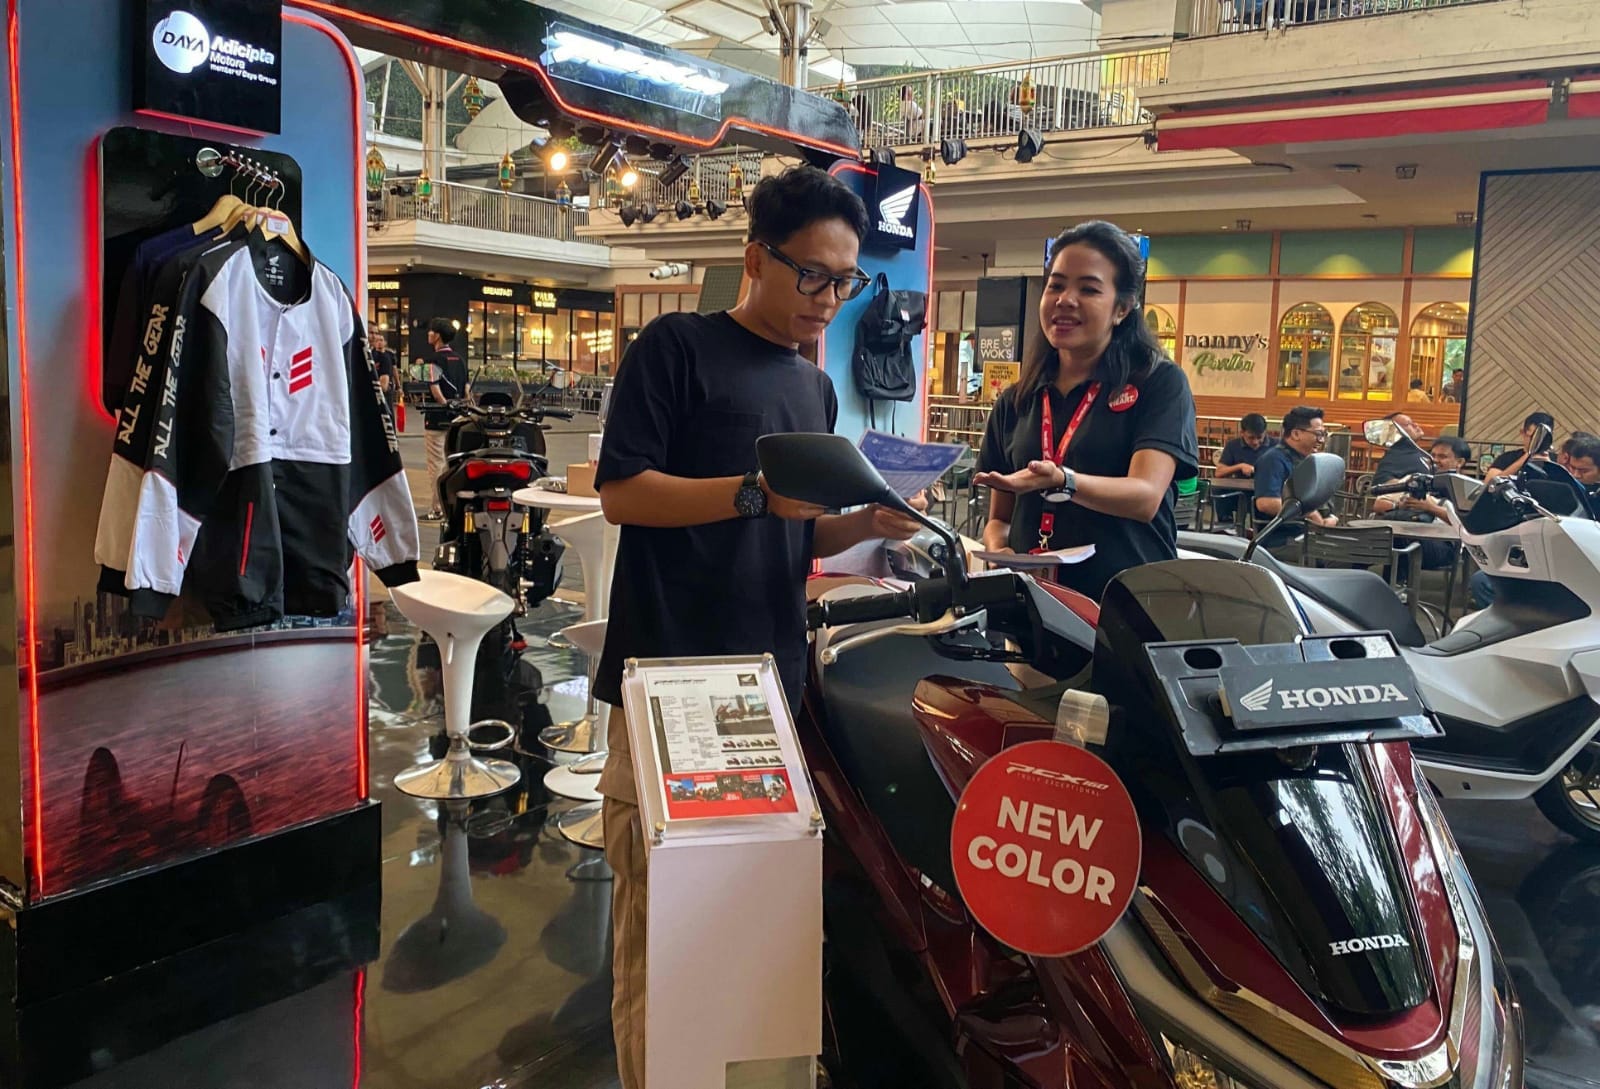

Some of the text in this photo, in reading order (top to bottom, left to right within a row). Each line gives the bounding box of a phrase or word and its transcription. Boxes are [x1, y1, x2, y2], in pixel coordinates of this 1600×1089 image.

[162, 31, 204, 53] DAYA
[211, 36, 275, 65] Adicipta
[210, 51, 245, 70] Motora
[878, 221, 914, 238] HONDA
[980, 338, 1000, 349] BRE
[1184, 333, 1270, 355] nanny's
[118, 303, 170, 445] ALL THE GEAR
[154, 315, 187, 459] ALL THE GEAR
[1277, 684, 1408, 709] HONDA
[997, 796, 1103, 850] NEW
[968, 835, 1116, 906] COLOR
[1328, 933, 1410, 956] HONDA
